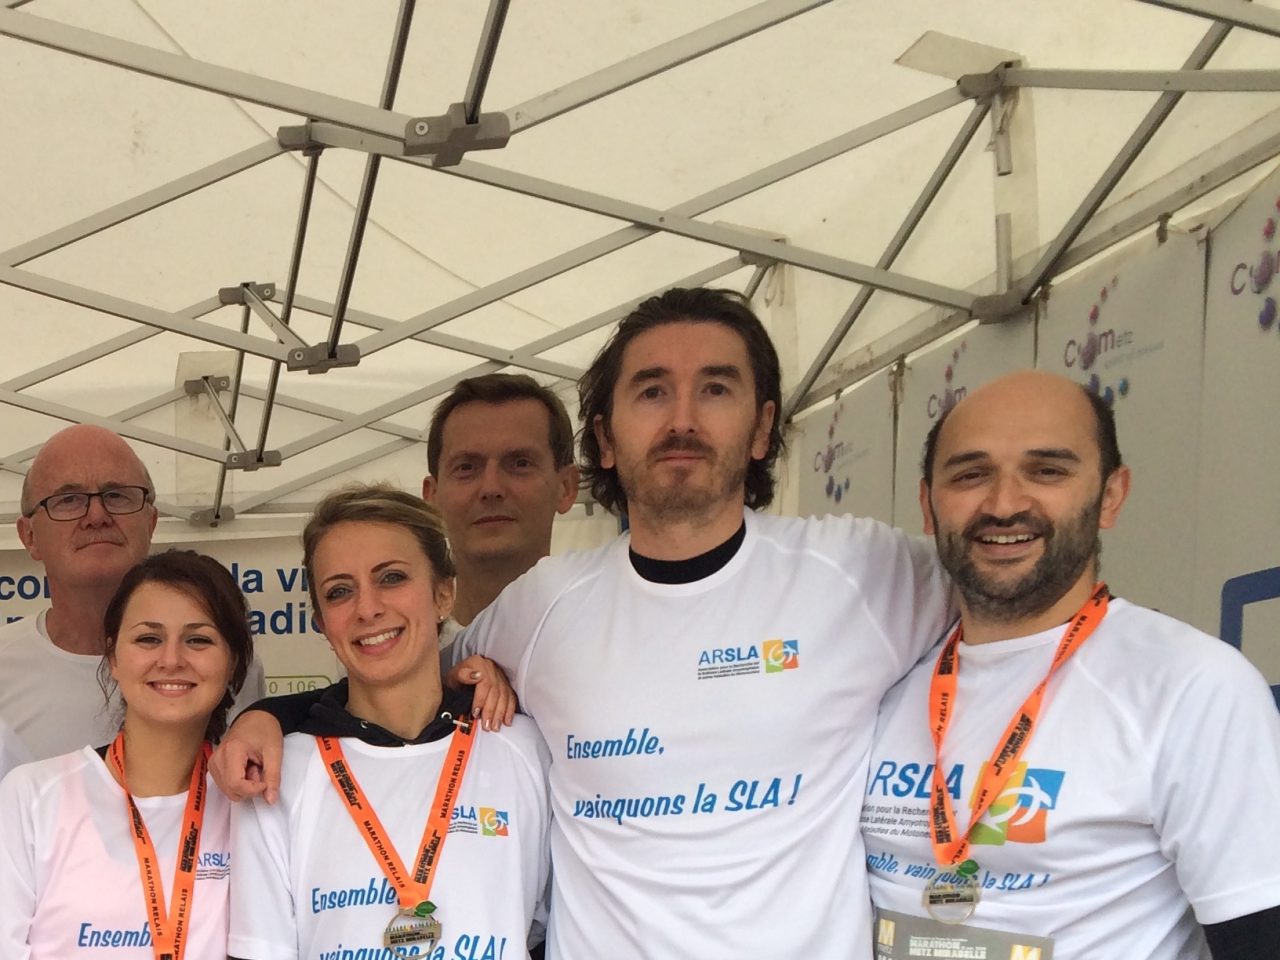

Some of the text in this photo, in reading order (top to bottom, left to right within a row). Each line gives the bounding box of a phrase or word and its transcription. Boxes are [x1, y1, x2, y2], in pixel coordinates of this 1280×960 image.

[698, 645, 760, 666] ARSLA
[567, 727, 665, 759] Ensemble,
[439, 749, 466, 819] MARATHON RELAIS
[573, 793, 685, 826] vainquons
[692, 783, 718, 814] la
[724, 777, 782, 812] SLA
[363, 819, 406, 888] MARATHON RELAIS
[144, 857, 163, 937] MARATHON RELAIS
[909, 939, 960, 949] MARATHON
